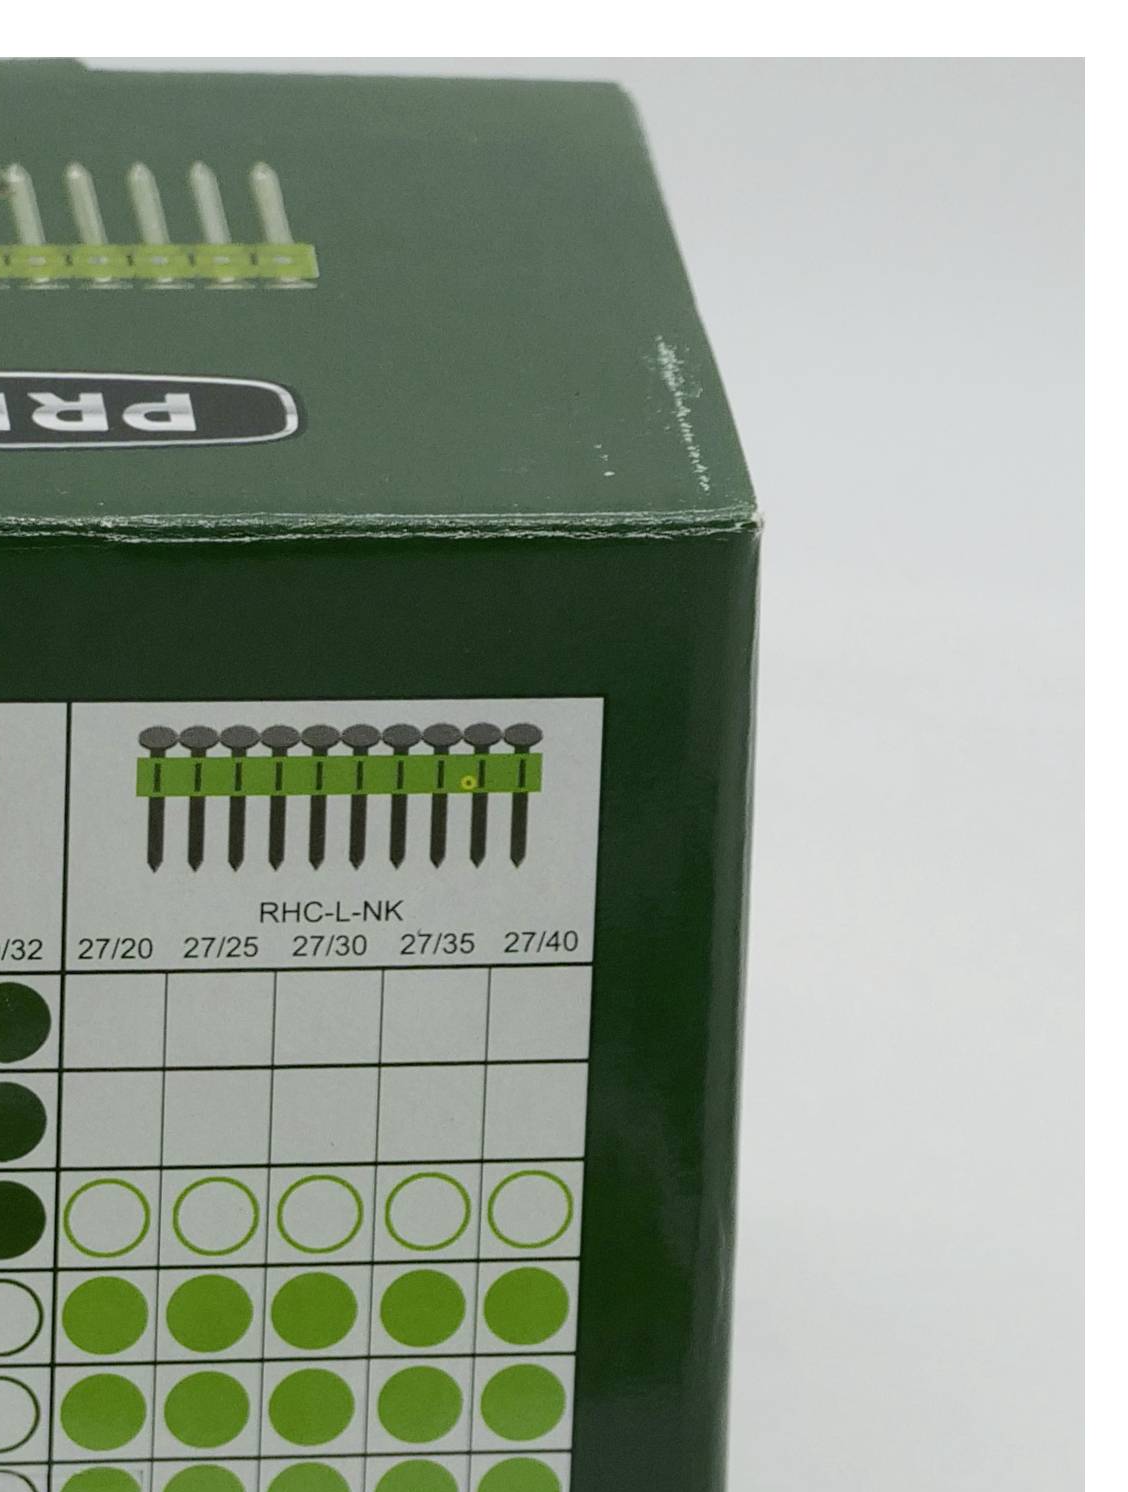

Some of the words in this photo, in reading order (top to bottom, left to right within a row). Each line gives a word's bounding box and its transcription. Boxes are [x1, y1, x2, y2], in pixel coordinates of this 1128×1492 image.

[260, 900, 403, 923] RHC-L-NK
[78, 938, 153, 960] 27/20
[184, 936, 258, 958] 27/25
[292, 934, 367, 957] 27/30
[400, 930, 475, 955] 27/35
[504, 930, 578, 953] 27/40
